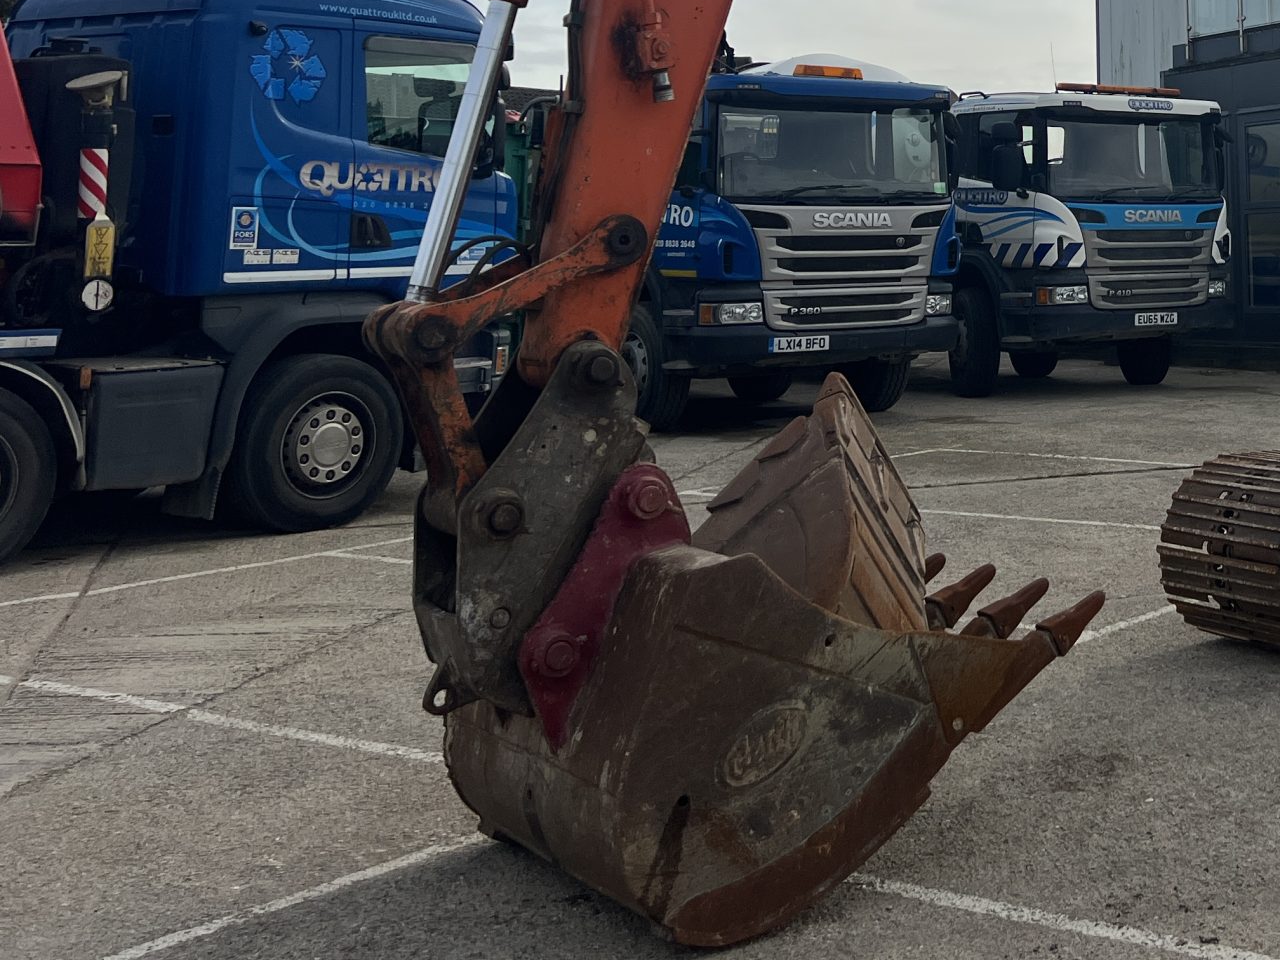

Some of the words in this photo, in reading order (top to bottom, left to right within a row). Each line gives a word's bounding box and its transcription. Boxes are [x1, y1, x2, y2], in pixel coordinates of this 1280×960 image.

[319, 3, 438, 24] www.quattroukltd.co.uk
[300, 160, 442, 197] QUATTR
[813, 212, 892, 228] SCANIA
[1124, 209, 1182, 222] SCANIA
[1116, 289, 1132, 297] 410
[790, 308, 799, 316] P
[799, 307, 822, 315] 360
[1137, 314, 1158, 324] EU65
[1160, 313, 1175, 323] WZG
[777, 338, 803, 351] LX14
[805, 337, 826, 350] BFO
